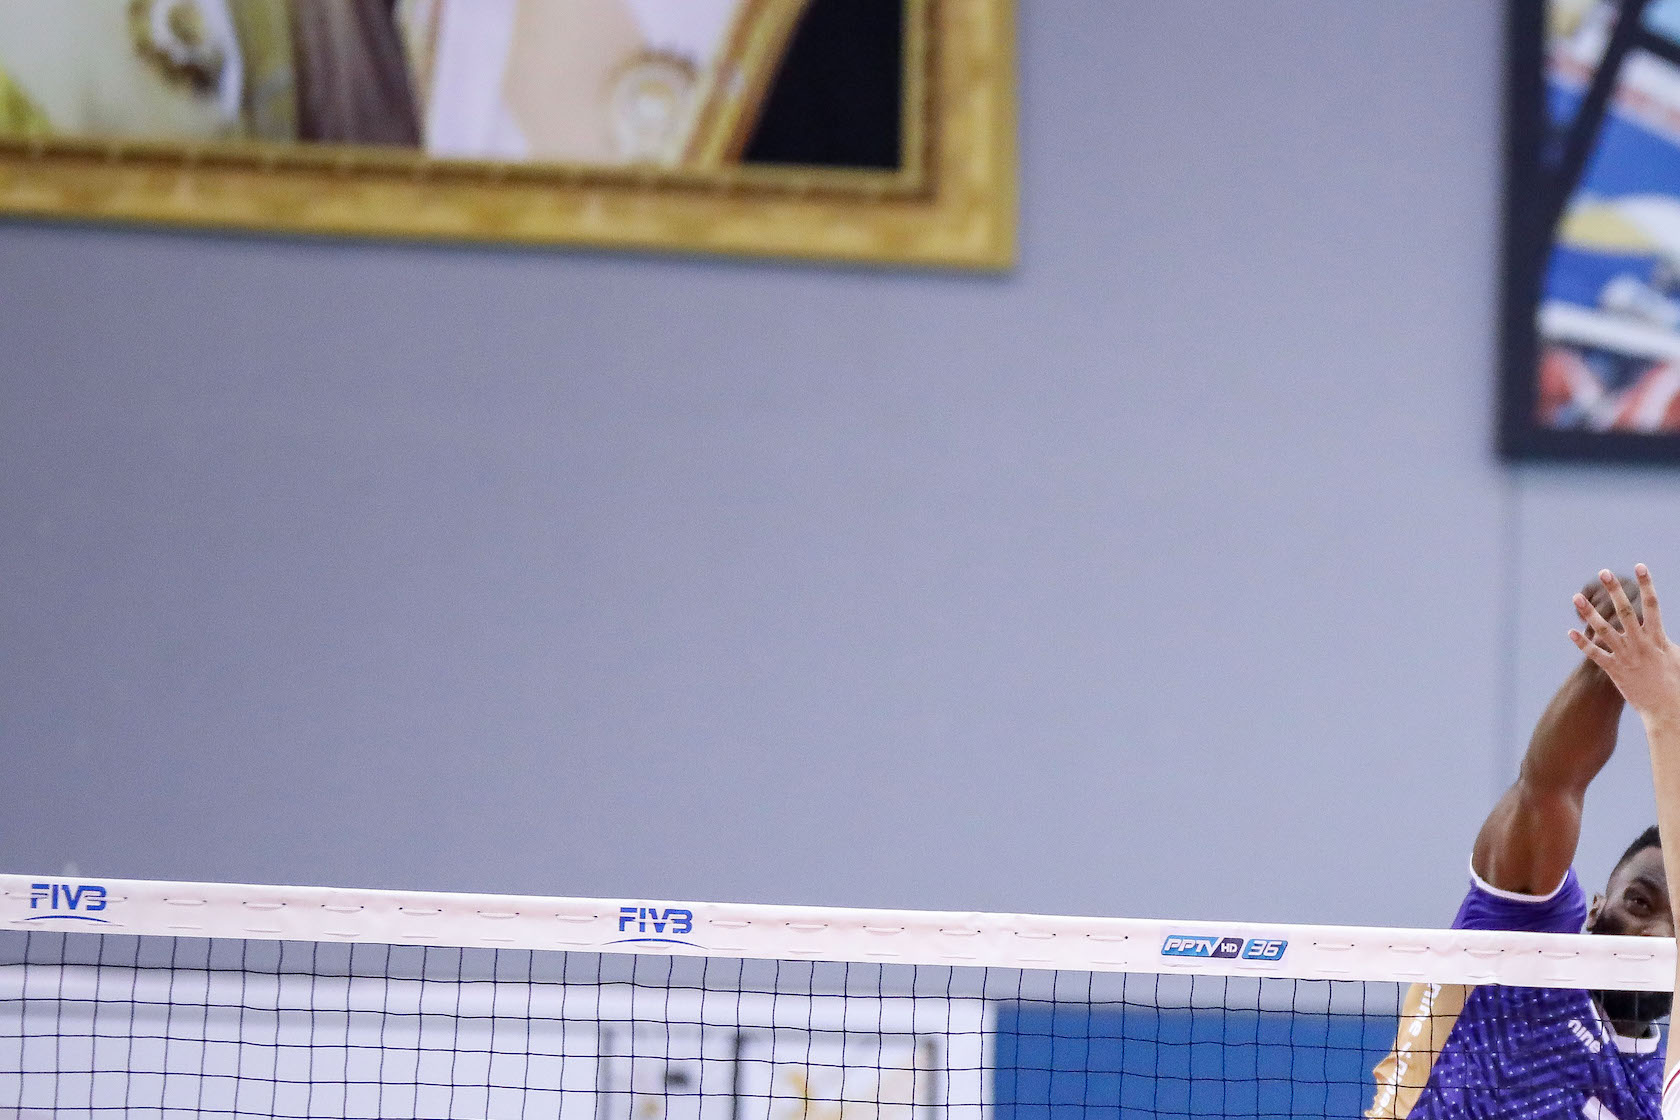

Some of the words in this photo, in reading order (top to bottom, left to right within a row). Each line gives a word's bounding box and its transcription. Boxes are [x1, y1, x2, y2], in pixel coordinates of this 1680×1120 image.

[30, 883, 107, 911] FIVB
[619, 907, 693, 934] FIVB
[1164, 938, 1220, 956] PPTV
[1220, 942, 1238, 953] HD
[1247, 940, 1282, 957] 36
